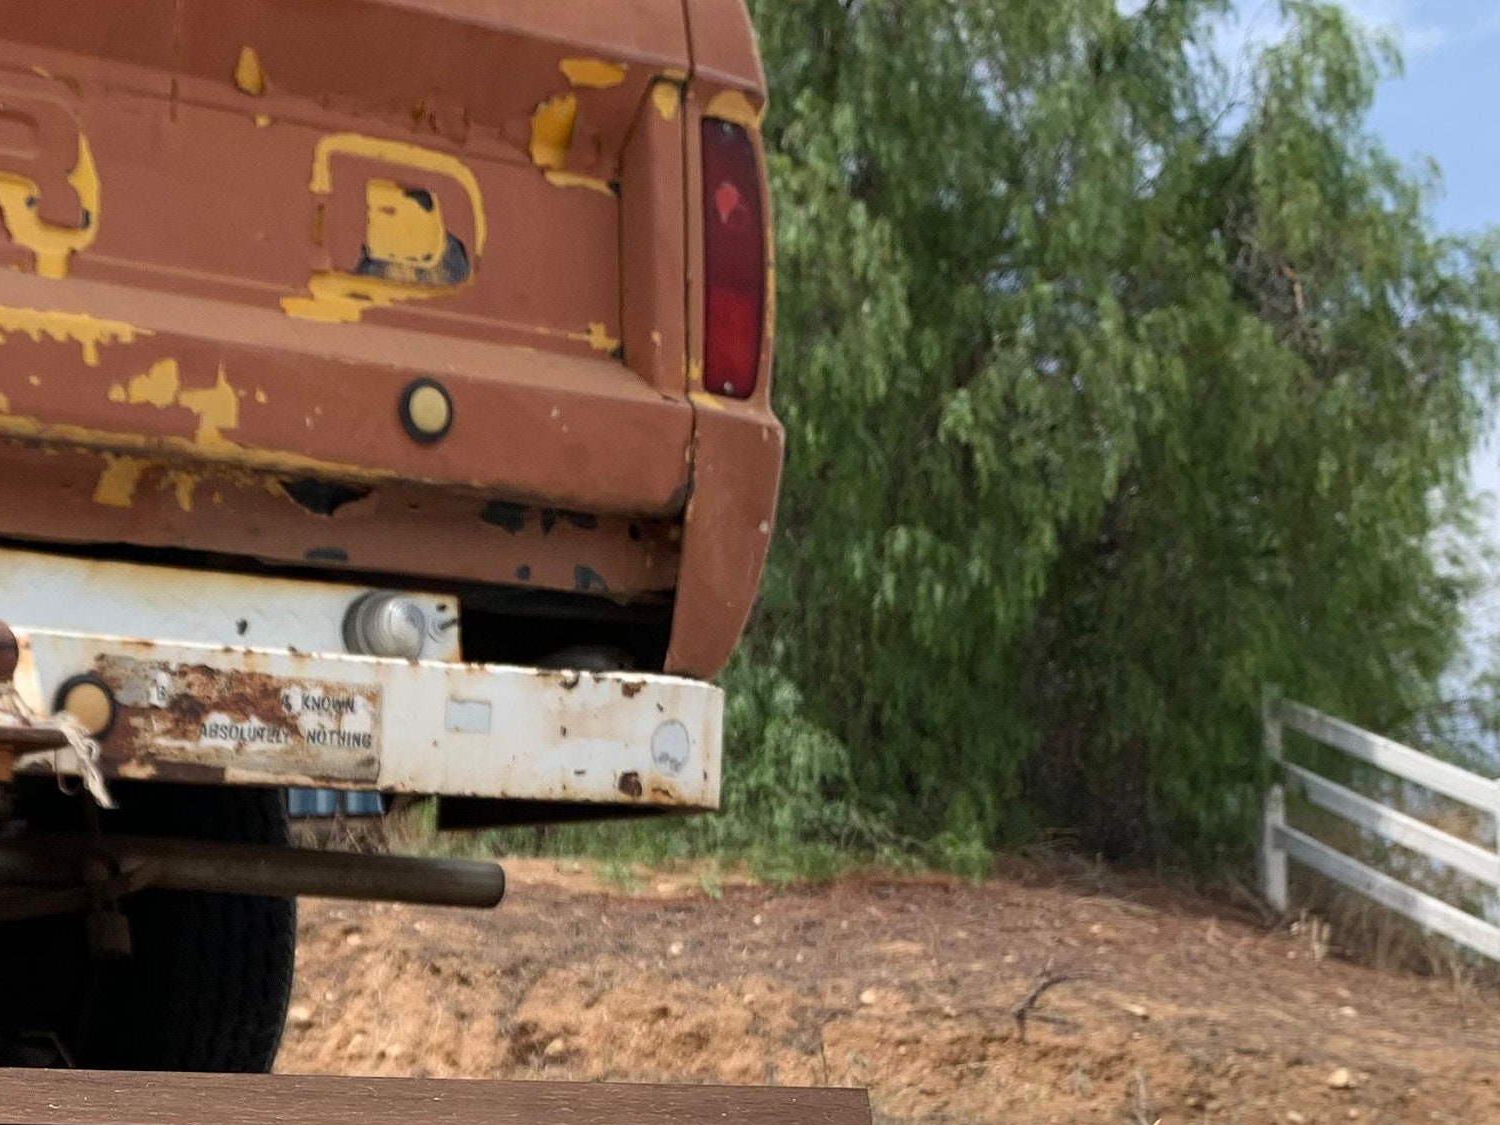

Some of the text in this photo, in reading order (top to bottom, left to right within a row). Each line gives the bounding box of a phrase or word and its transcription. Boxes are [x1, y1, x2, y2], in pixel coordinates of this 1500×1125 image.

[302, 693, 355, 714] KNOWN
[199, 721, 373, 750] ABSOLUTELY NOTHING
